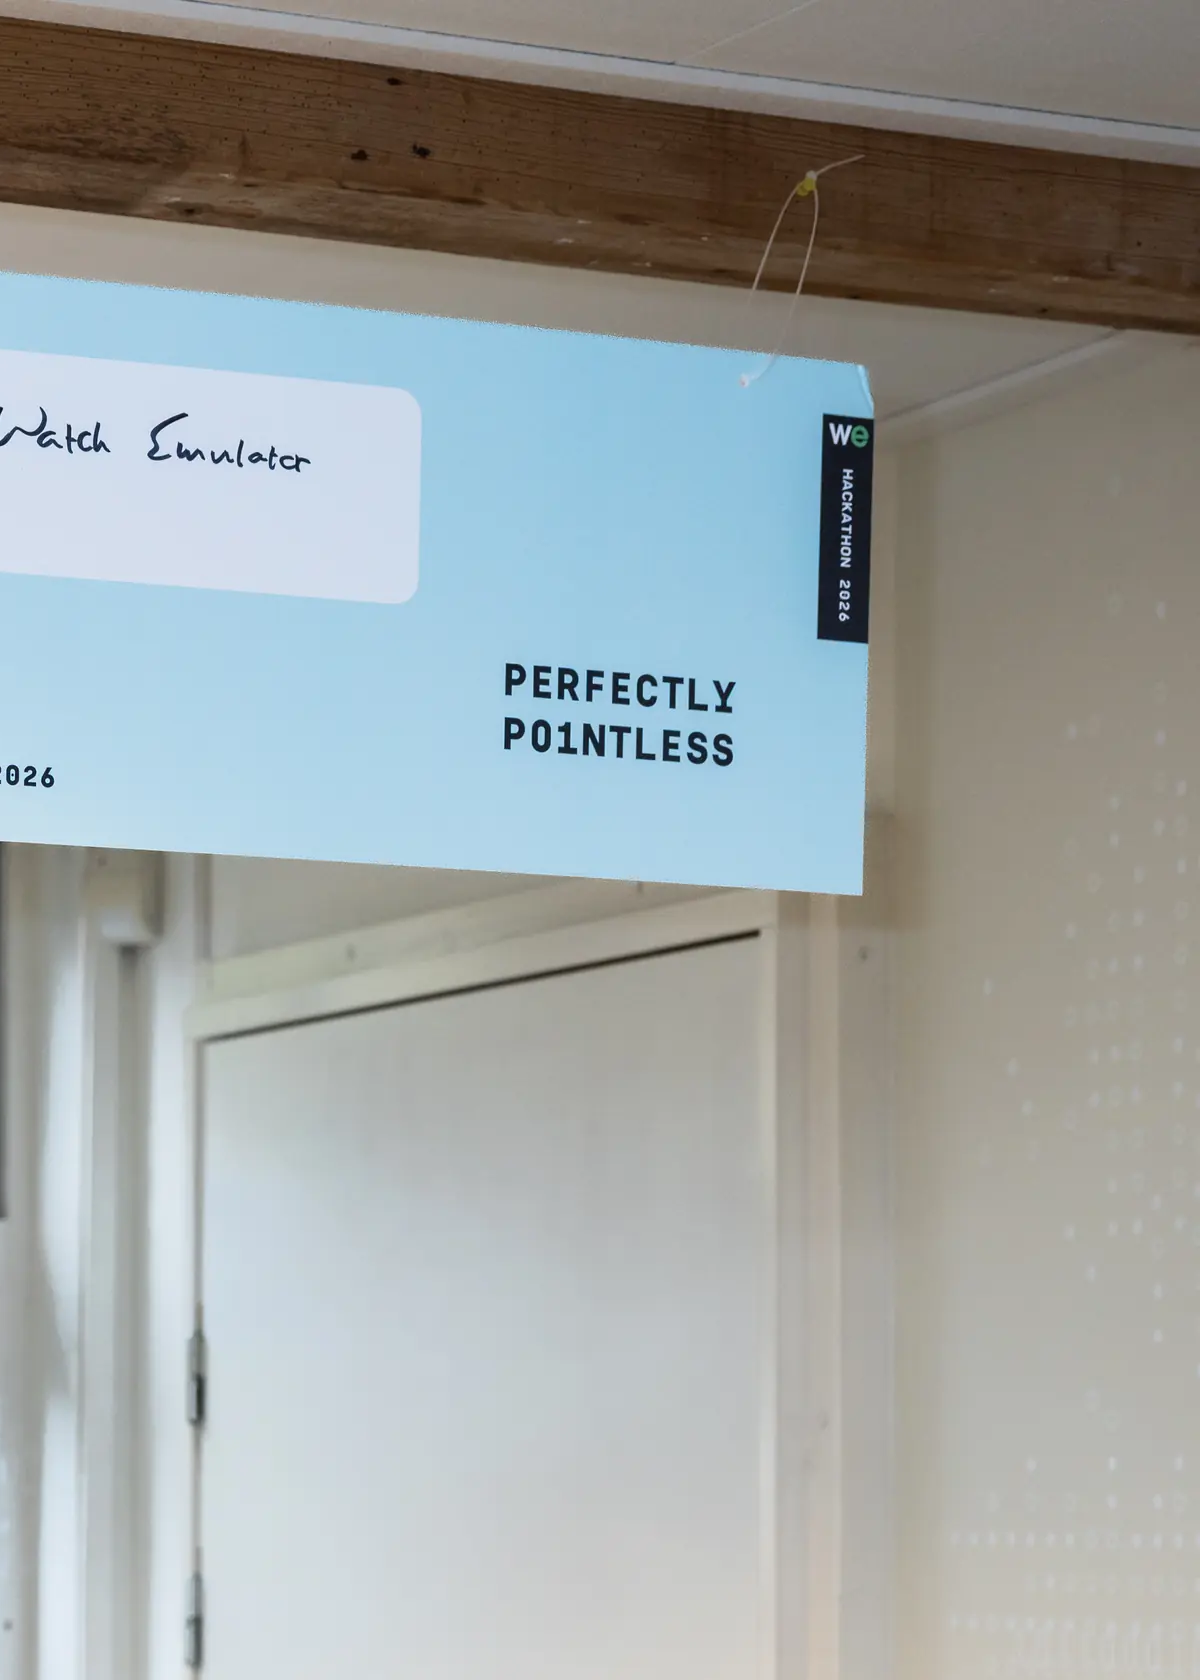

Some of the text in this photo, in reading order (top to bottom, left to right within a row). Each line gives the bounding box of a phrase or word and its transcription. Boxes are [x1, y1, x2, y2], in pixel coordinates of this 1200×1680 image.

[839, 468, 853, 622] HACKATHON 2026
[505, 663, 736, 713] PERFECTLY
